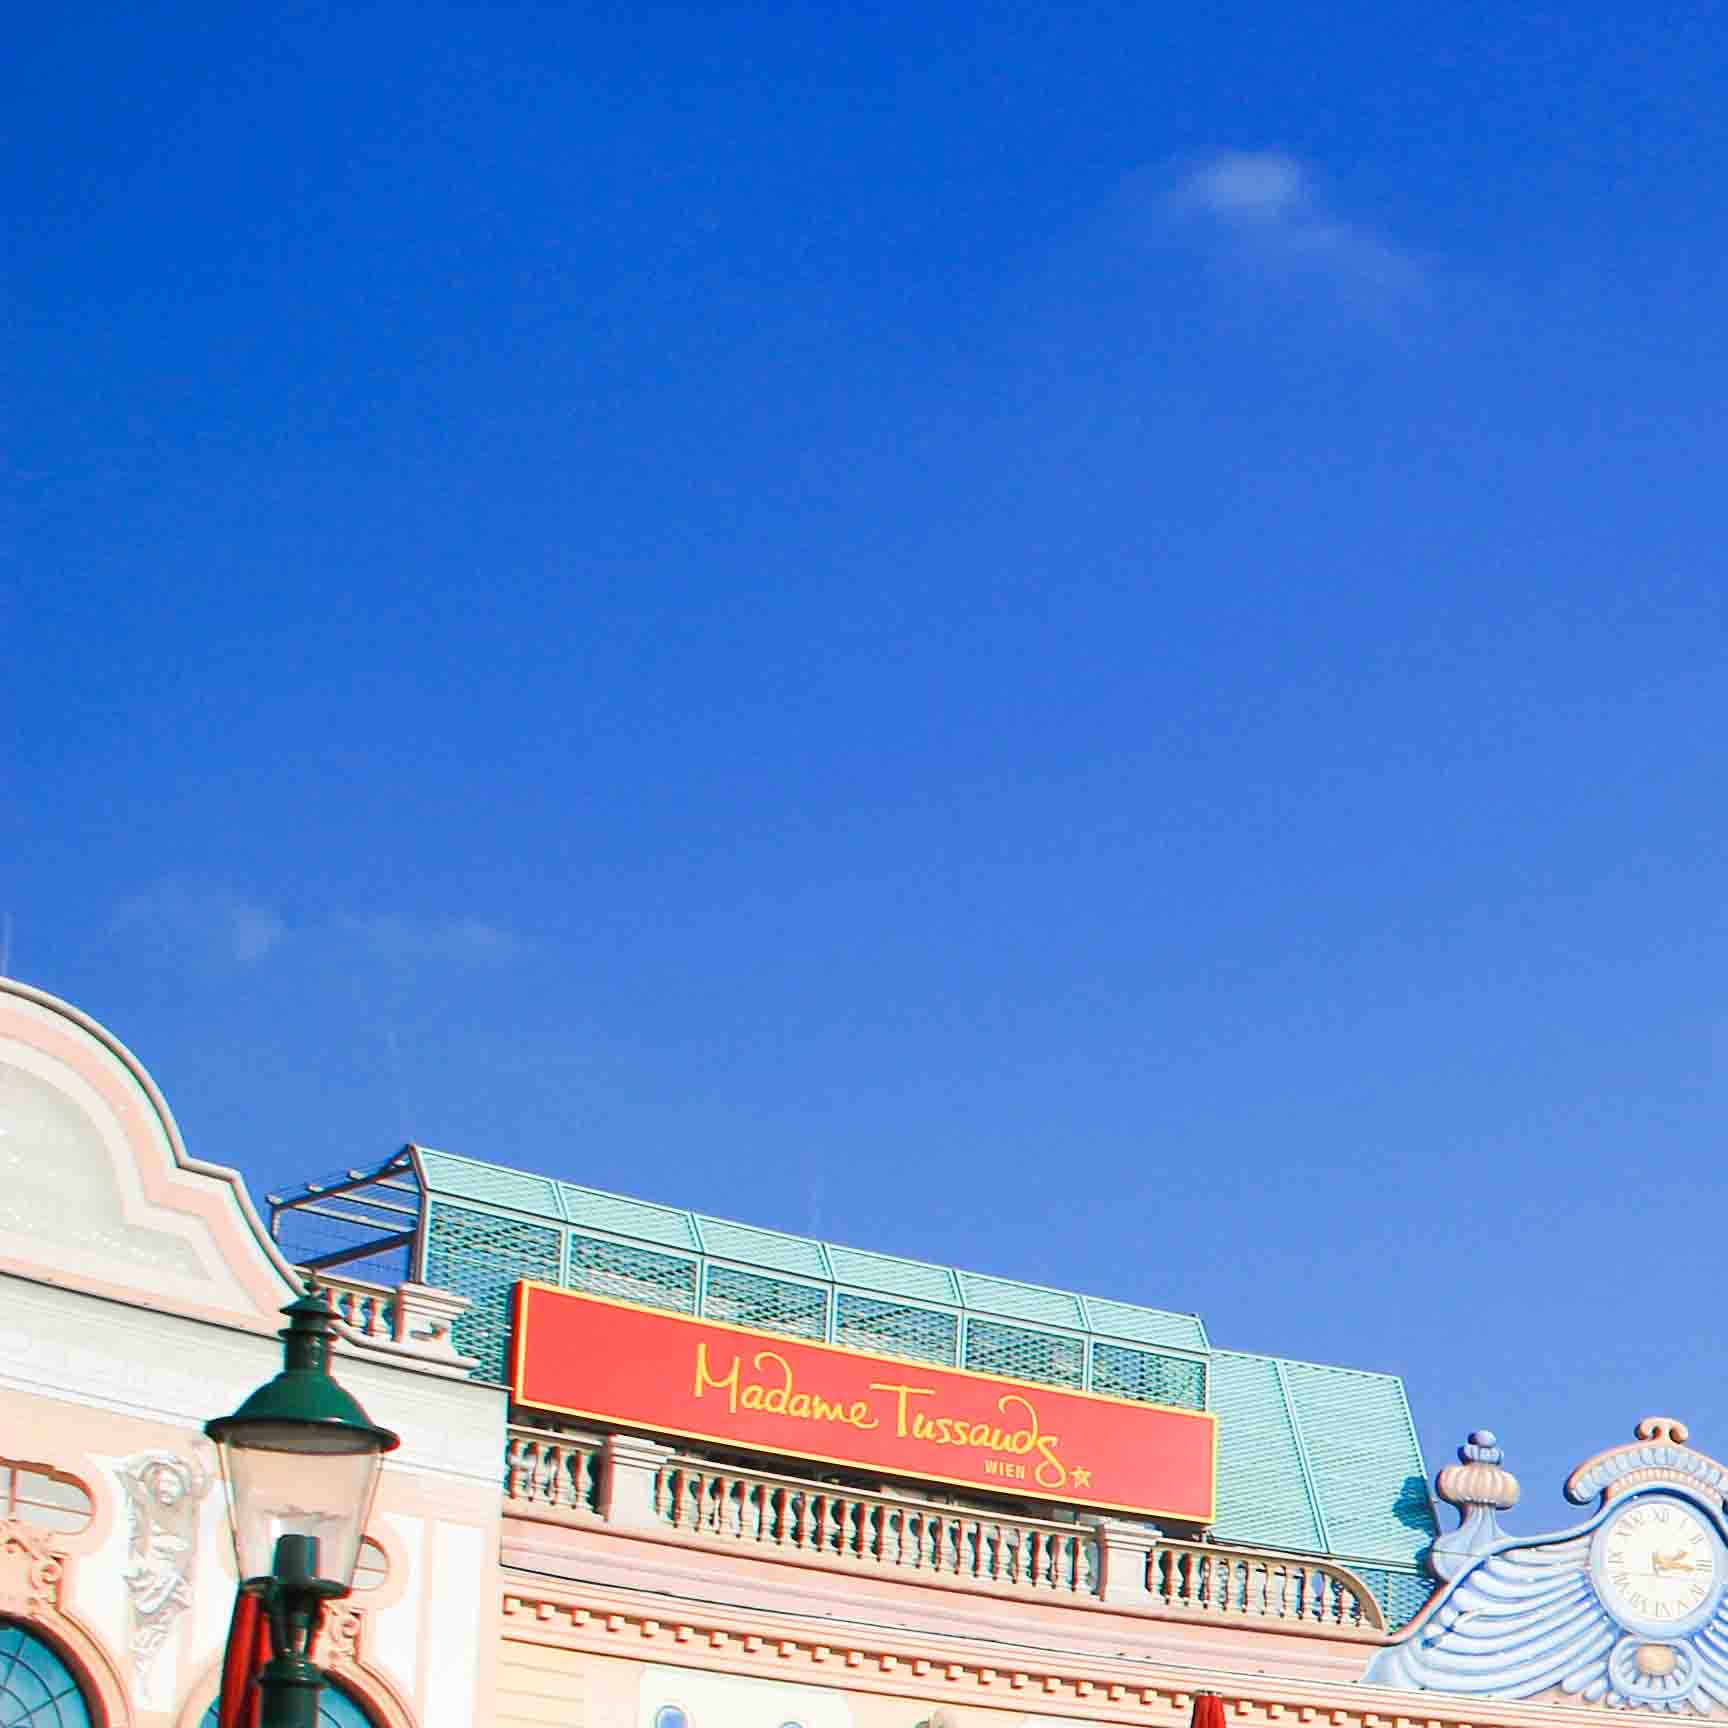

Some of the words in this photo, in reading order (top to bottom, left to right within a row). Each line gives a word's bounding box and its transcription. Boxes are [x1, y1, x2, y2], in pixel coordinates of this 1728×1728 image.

[694, 1343, 881, 1430] Madame
[868, 1383, 1067, 1489] Tussauds
[984, 1459, 1025, 1480] WIEN
